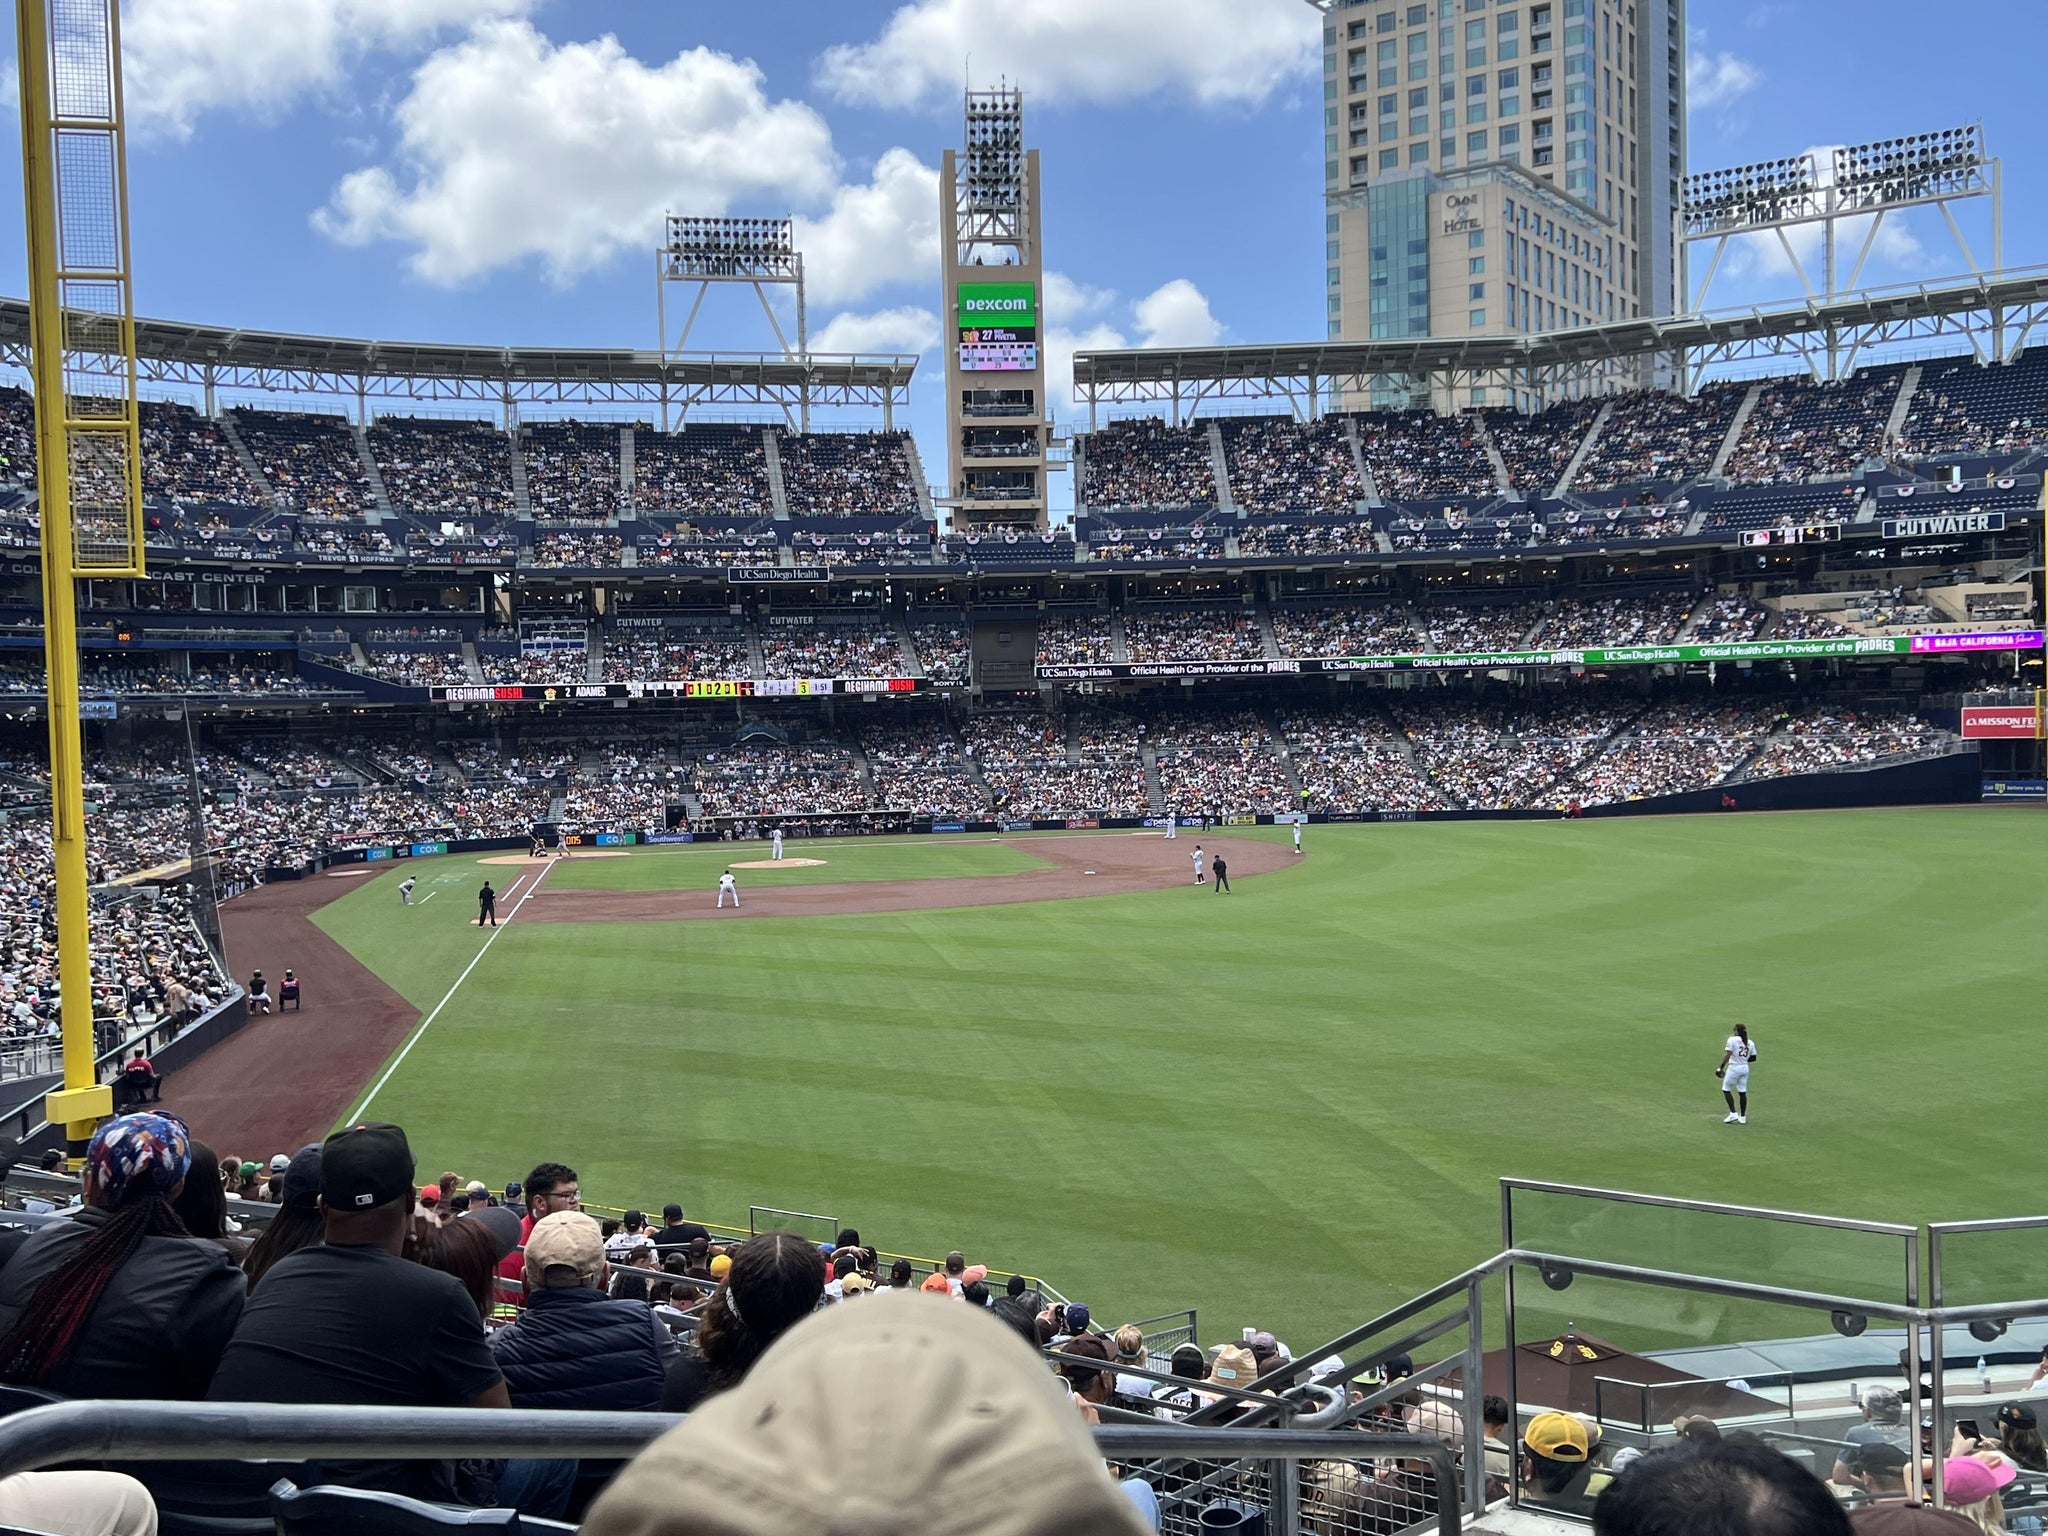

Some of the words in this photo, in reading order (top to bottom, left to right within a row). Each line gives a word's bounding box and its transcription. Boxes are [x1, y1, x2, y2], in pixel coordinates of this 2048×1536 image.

[1444, 218, 1481, 233] HOTEL
[982, 329, 993, 340] 27
[1895, 515, 1989, 536] CUTWATER
[14, 538, 24, 547] 31
[214, 551, 238, 559] RANDY
[241, 552, 252, 560] 35
[349, 555, 358, 563] 51
[453, 557, 464, 565] 42
[465, 557, 501, 565] ROBINSON
[201, 573, 265, 583] CENTER
[739, 569, 752, 578] UC
[753, 569, 769, 578] San
[770, 569, 792, 580] Diego
[793, 568, 819, 578] Health
[616, 618, 662, 627] CUTWATER
[770, 616, 814, 625] CUTWATER
[1699, 647, 1731, 657] Official
[1732, 645, 1761, 656] Health
[1763, 645, 1783, 654] Care
[1785, 644, 1823, 653] Provider
[1825, 643, 1835, 652] of
[1836, 643, 1852, 652] the
[1855, 639, 1895, 653] PADRES
[1412, 658, 1441, 667] Official
[1443, 657, 1469, 666] Health
[1470, 656, 1489, 665] Care
[1490, 655, 1525, 665] Provider
[1526, 655, 1535, 663] of
[1536, 655, 1548, 663] the
[1550, 652, 1584, 665] PADRES
[1604, 651, 1617, 660] UC
[1617, 651, 1632, 660] San
[1632, 650, 1654, 661] Diego
[1655, 649, 1680, 658] Health
[1130, 666, 1158, 675] Official
[1159, 665, 1185, 674] Health
[1186, 665, 1204, 674] Care
[1206, 664, 1239, 673] Provider
[1240, 663, 1250, 672] of
[1250, 663, 1264, 672] the
[1267, 661, 1300, 673] PADRES
[1322, 661, 1334, 670] UC
[1334, 661, 1349, 669] San
[1349, 660, 1370, 670] Diego
[1370, 659, 1394, 668] Health
[1041, 668, 1053, 677] UC
[1054, 668, 1067, 677] San
[1068, 667, 1088, 678] Diego
[1089, 667, 1112, 676] Health
[565, 687, 571, 697] 2
[575, 686, 606, 697] ADAMES
[714, 683, 721, 695] 2
[1978, 717, 2020, 725] MISSION
[648, 836, 684, 844] Southwest
[420, 844, 439, 853] COX
[373, 850, 386, 859] COX
[1738, 1046, 1749, 1057] 23
